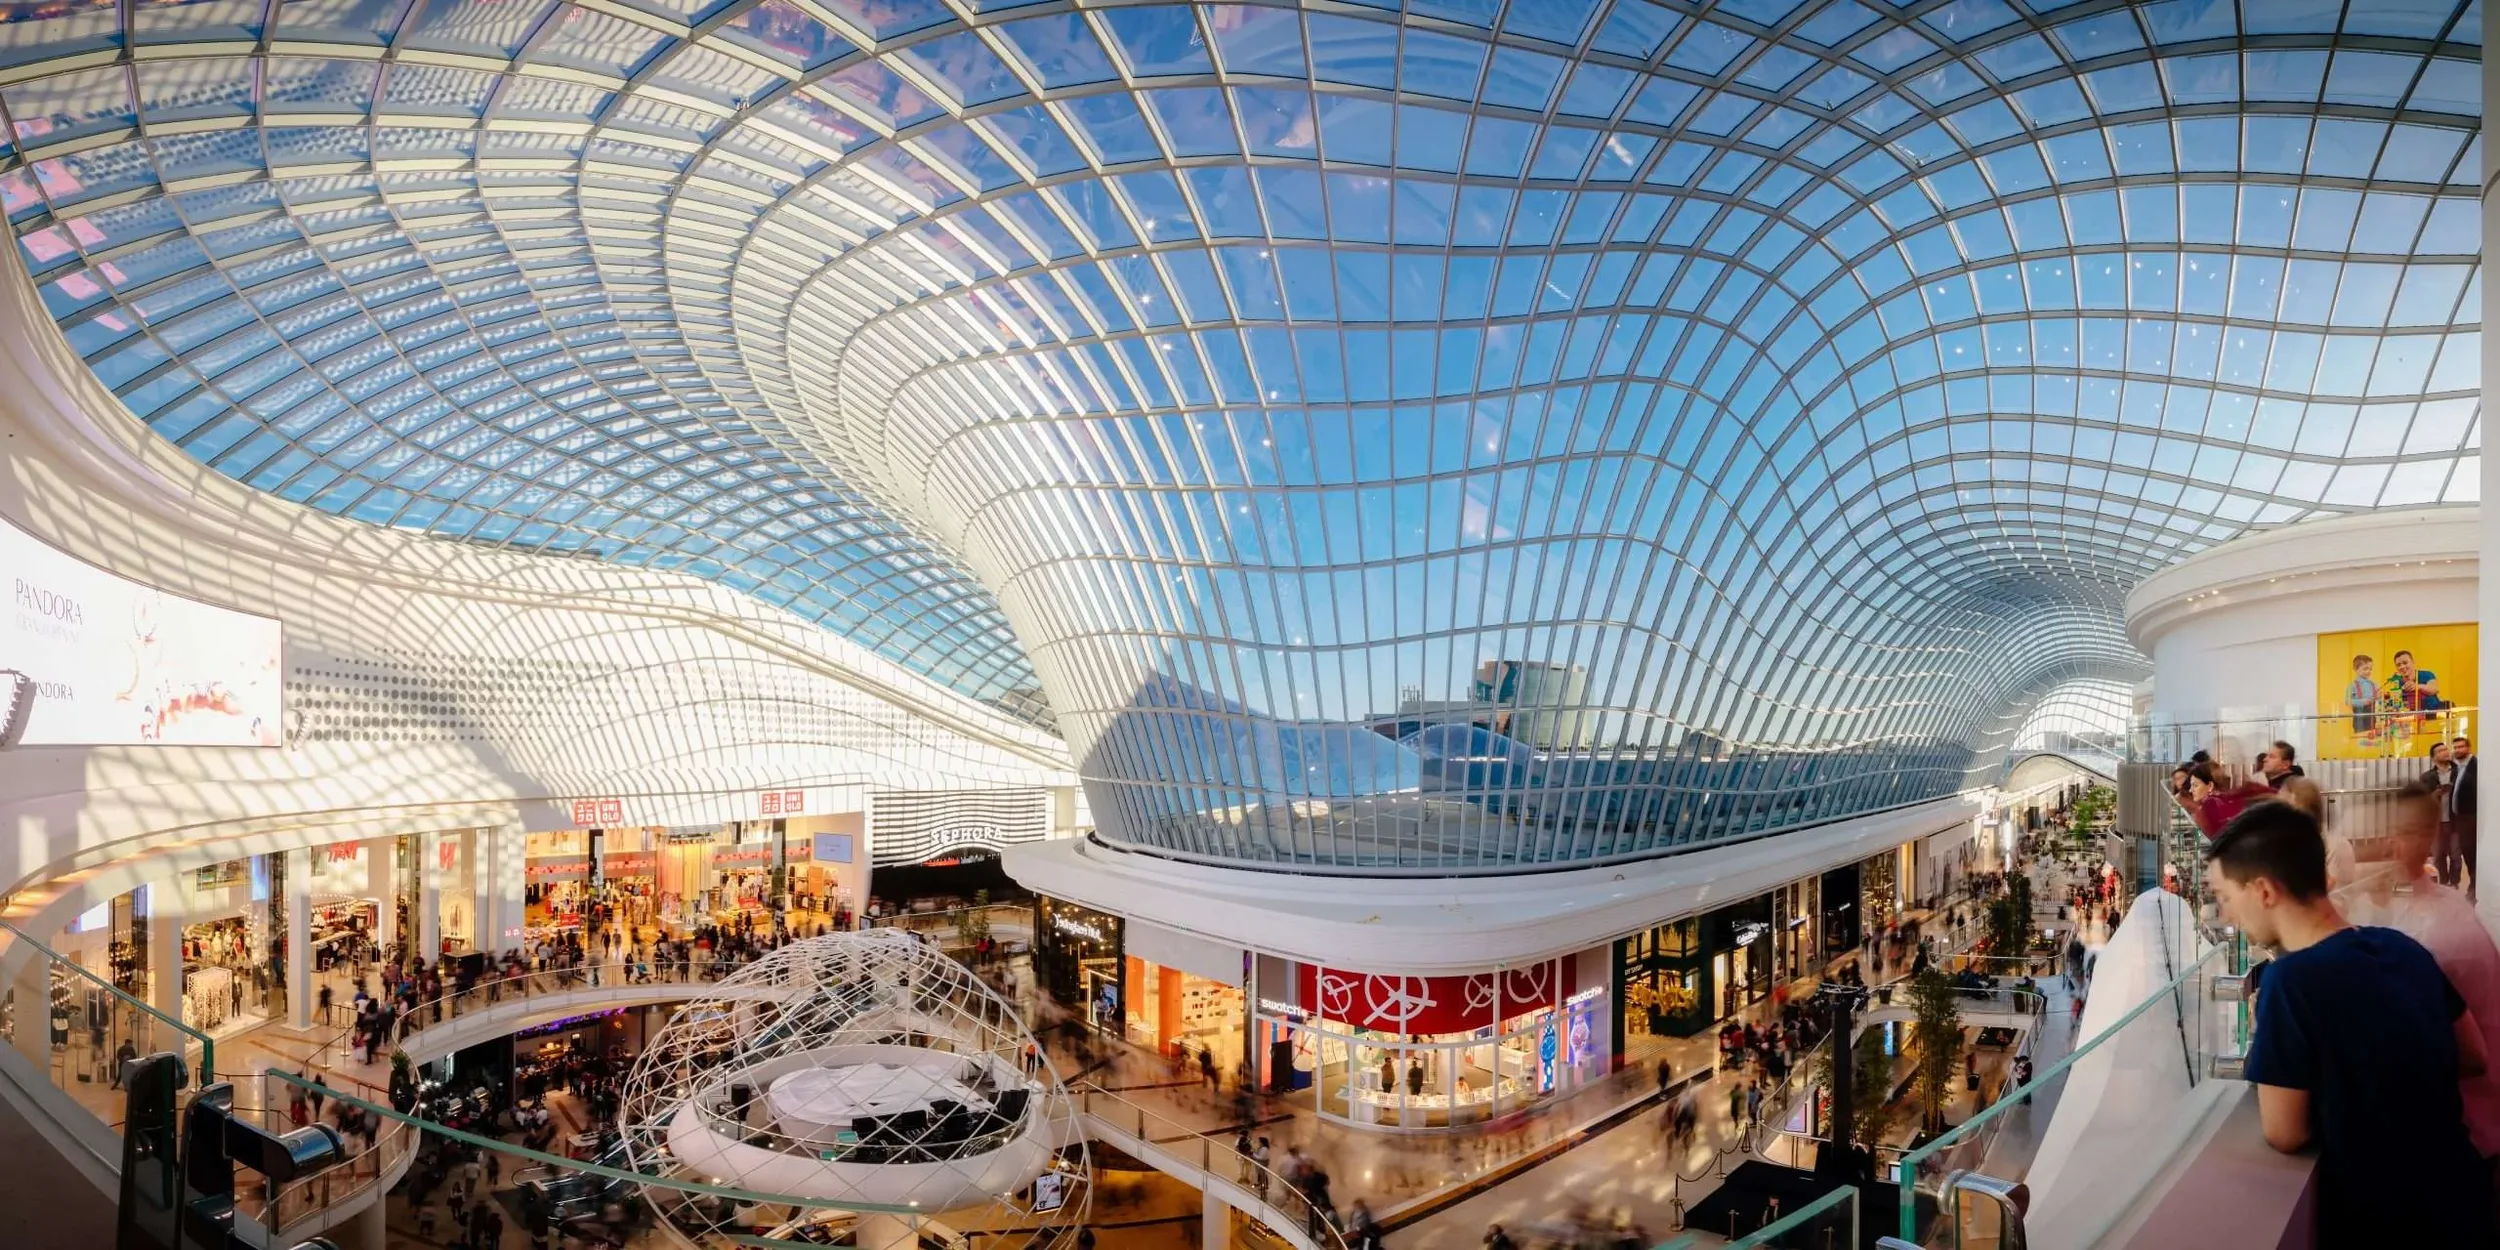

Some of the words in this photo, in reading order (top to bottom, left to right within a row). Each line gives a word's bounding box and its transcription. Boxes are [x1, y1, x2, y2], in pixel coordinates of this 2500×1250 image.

[15, 577, 83, 626] PANDORA
[36, 682, 74, 701] NDORA
[930, 826, 1002, 846] SEPHORA
[1566, 986, 1599, 1006] swatch
[1261, 998, 1301, 1016] swatch
